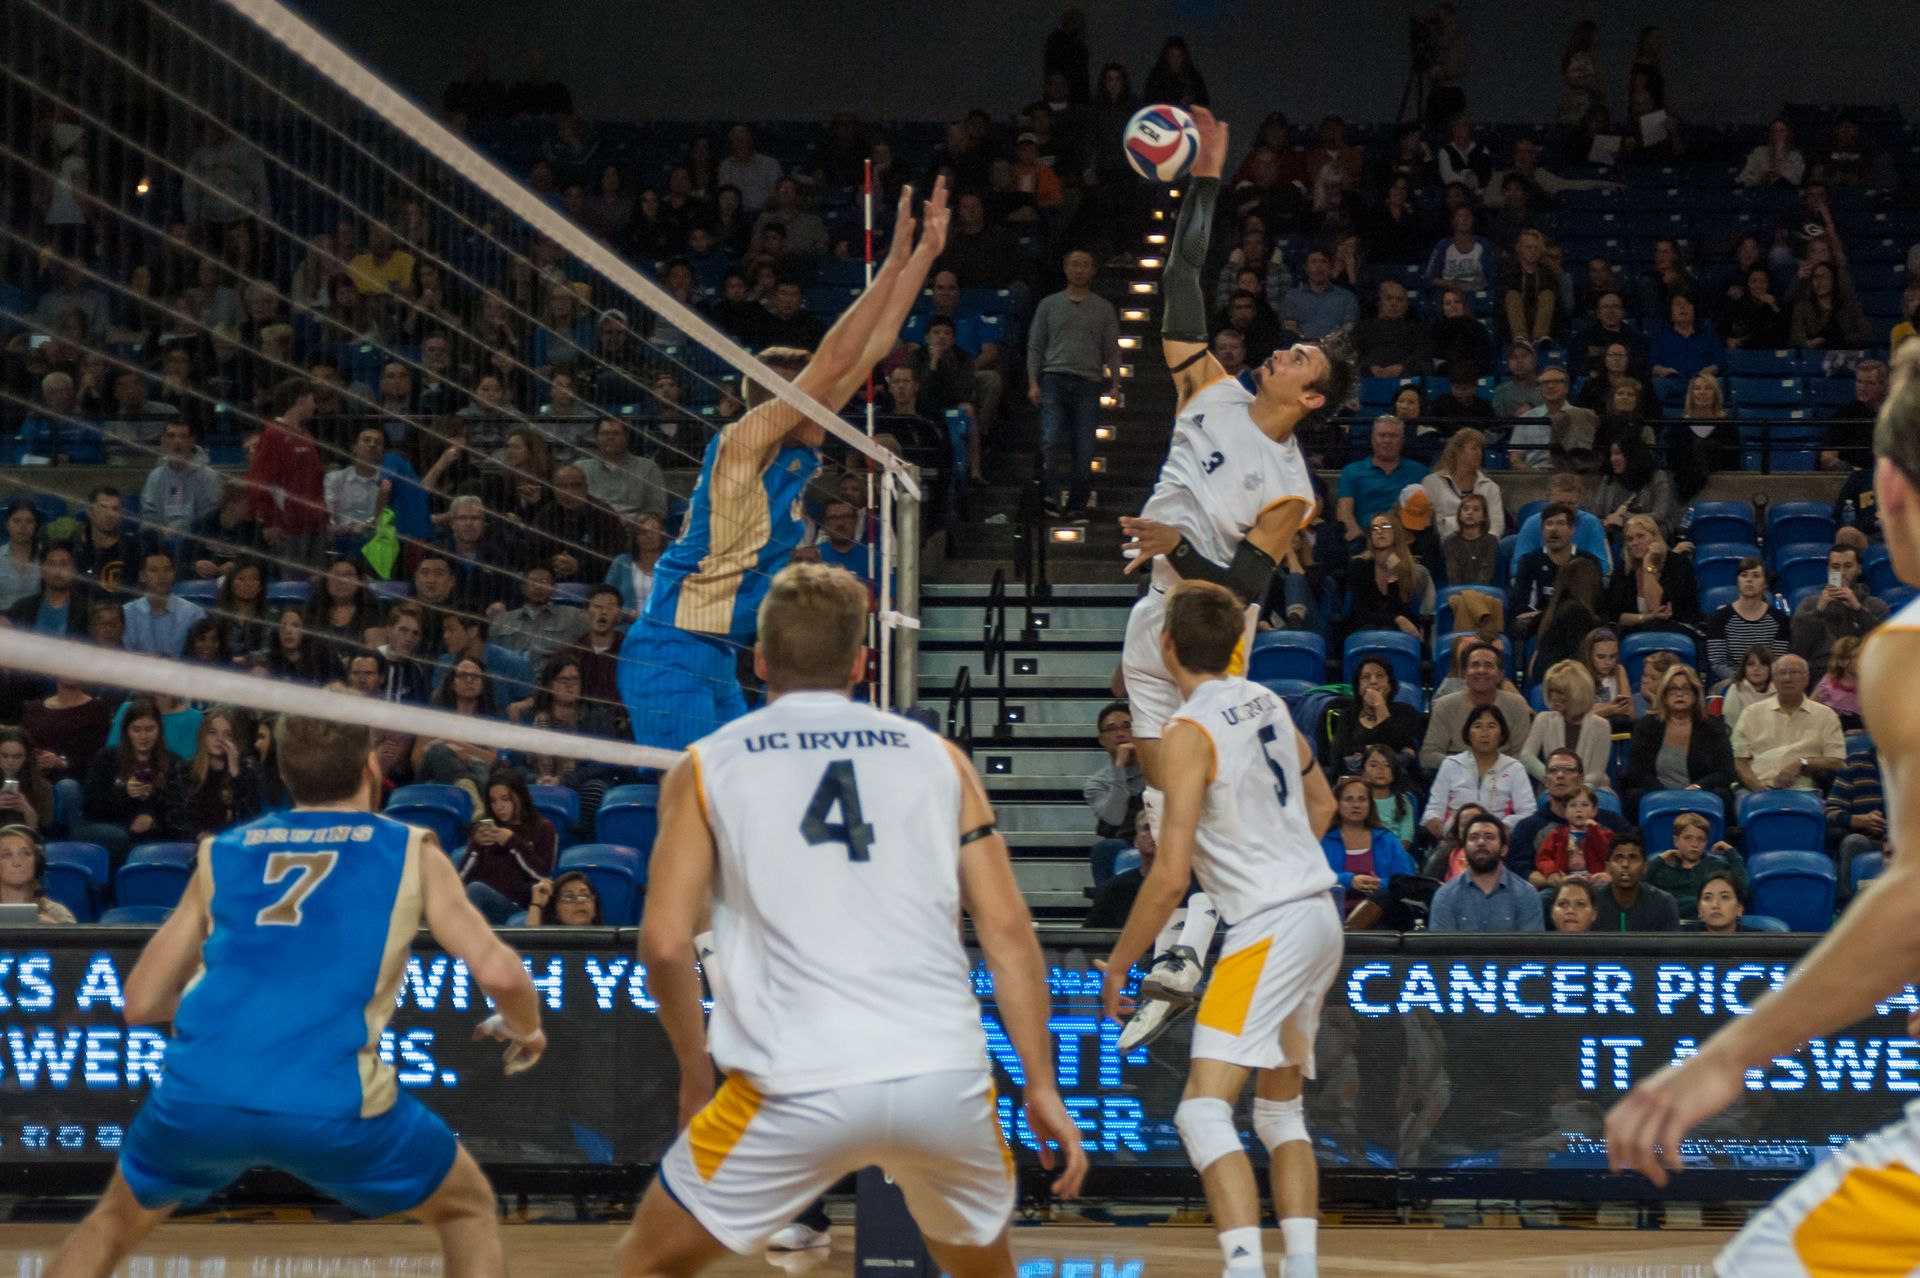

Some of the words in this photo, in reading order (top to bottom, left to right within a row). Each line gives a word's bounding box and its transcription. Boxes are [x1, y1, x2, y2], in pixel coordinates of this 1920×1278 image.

[1200, 451, 1225, 475] 3
[744, 732, 790, 753] UC
[797, 730, 910, 750] IRVINE
[1257, 724, 1289, 808] 5
[242, 825, 375, 847] BRUINS
[799, 758, 876, 863] 4
[255, 850, 340, 926] 7
[396, 957, 563, 1011] WIH
[1347, 963, 1636, 1016] CANCER
[1655, 963, 1797, 1016] PIC
[0, 1030, 167, 1086] WER
[1580, 1037, 1644, 1091] IT
